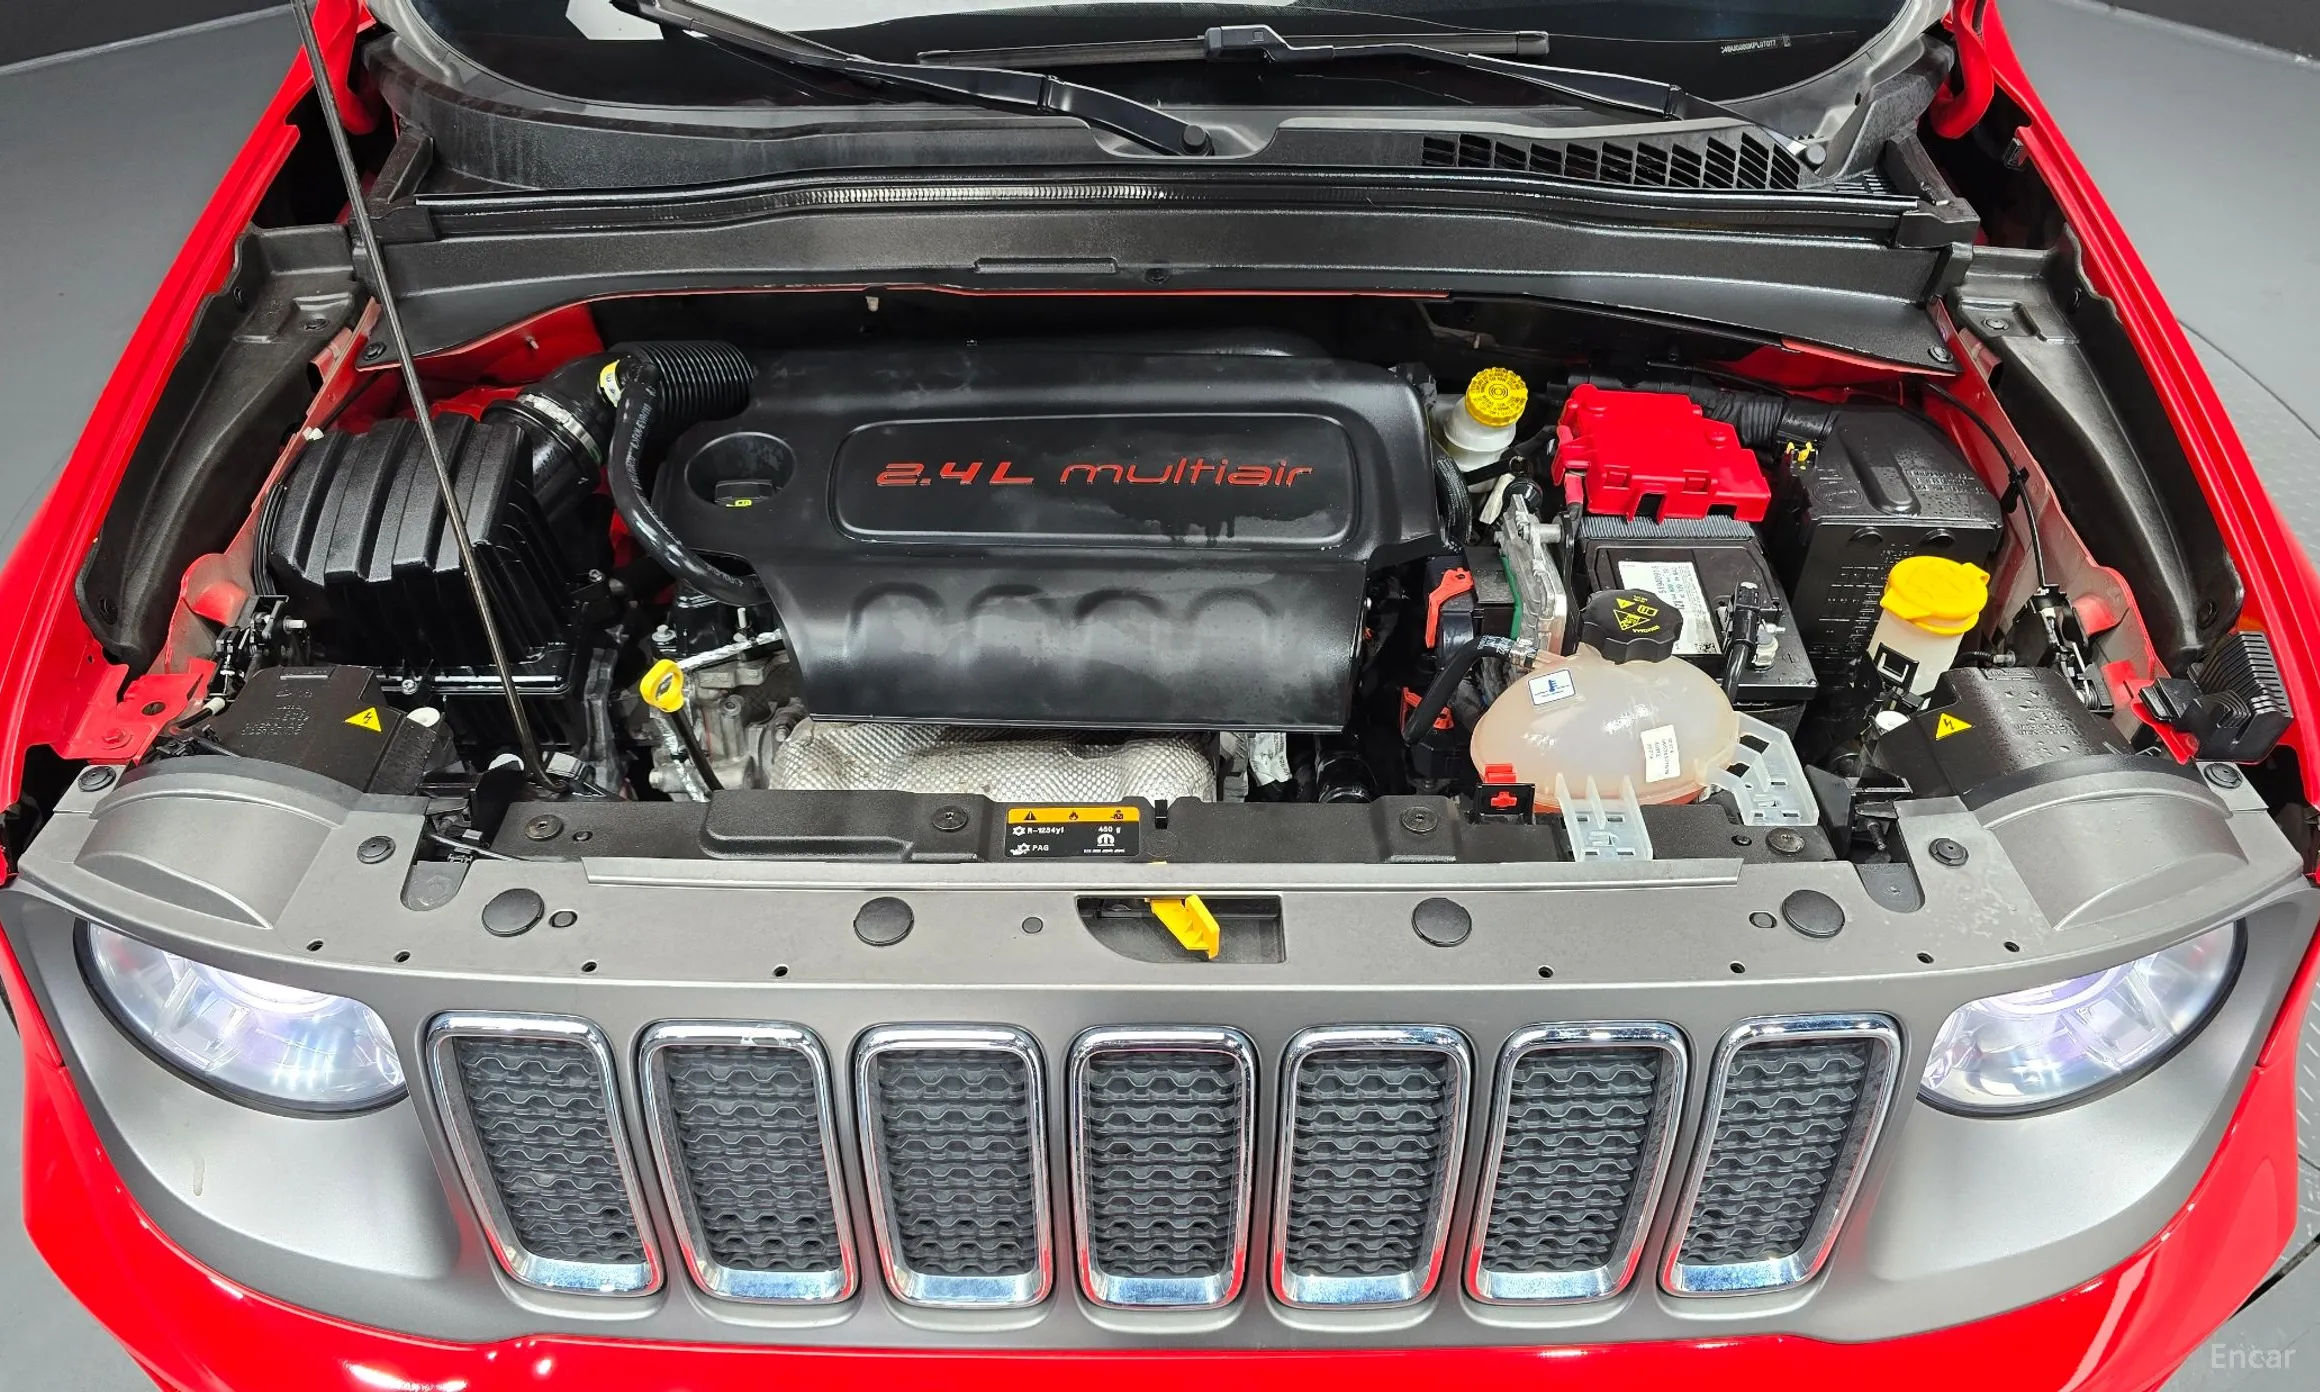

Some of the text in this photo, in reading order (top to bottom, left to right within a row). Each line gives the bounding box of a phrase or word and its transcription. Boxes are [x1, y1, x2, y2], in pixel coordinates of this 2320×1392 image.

[1059, 457, 1313, 487] multiair
[1098, 825, 1113, 833] 450
[1032, 844, 1050, 852] PAG
